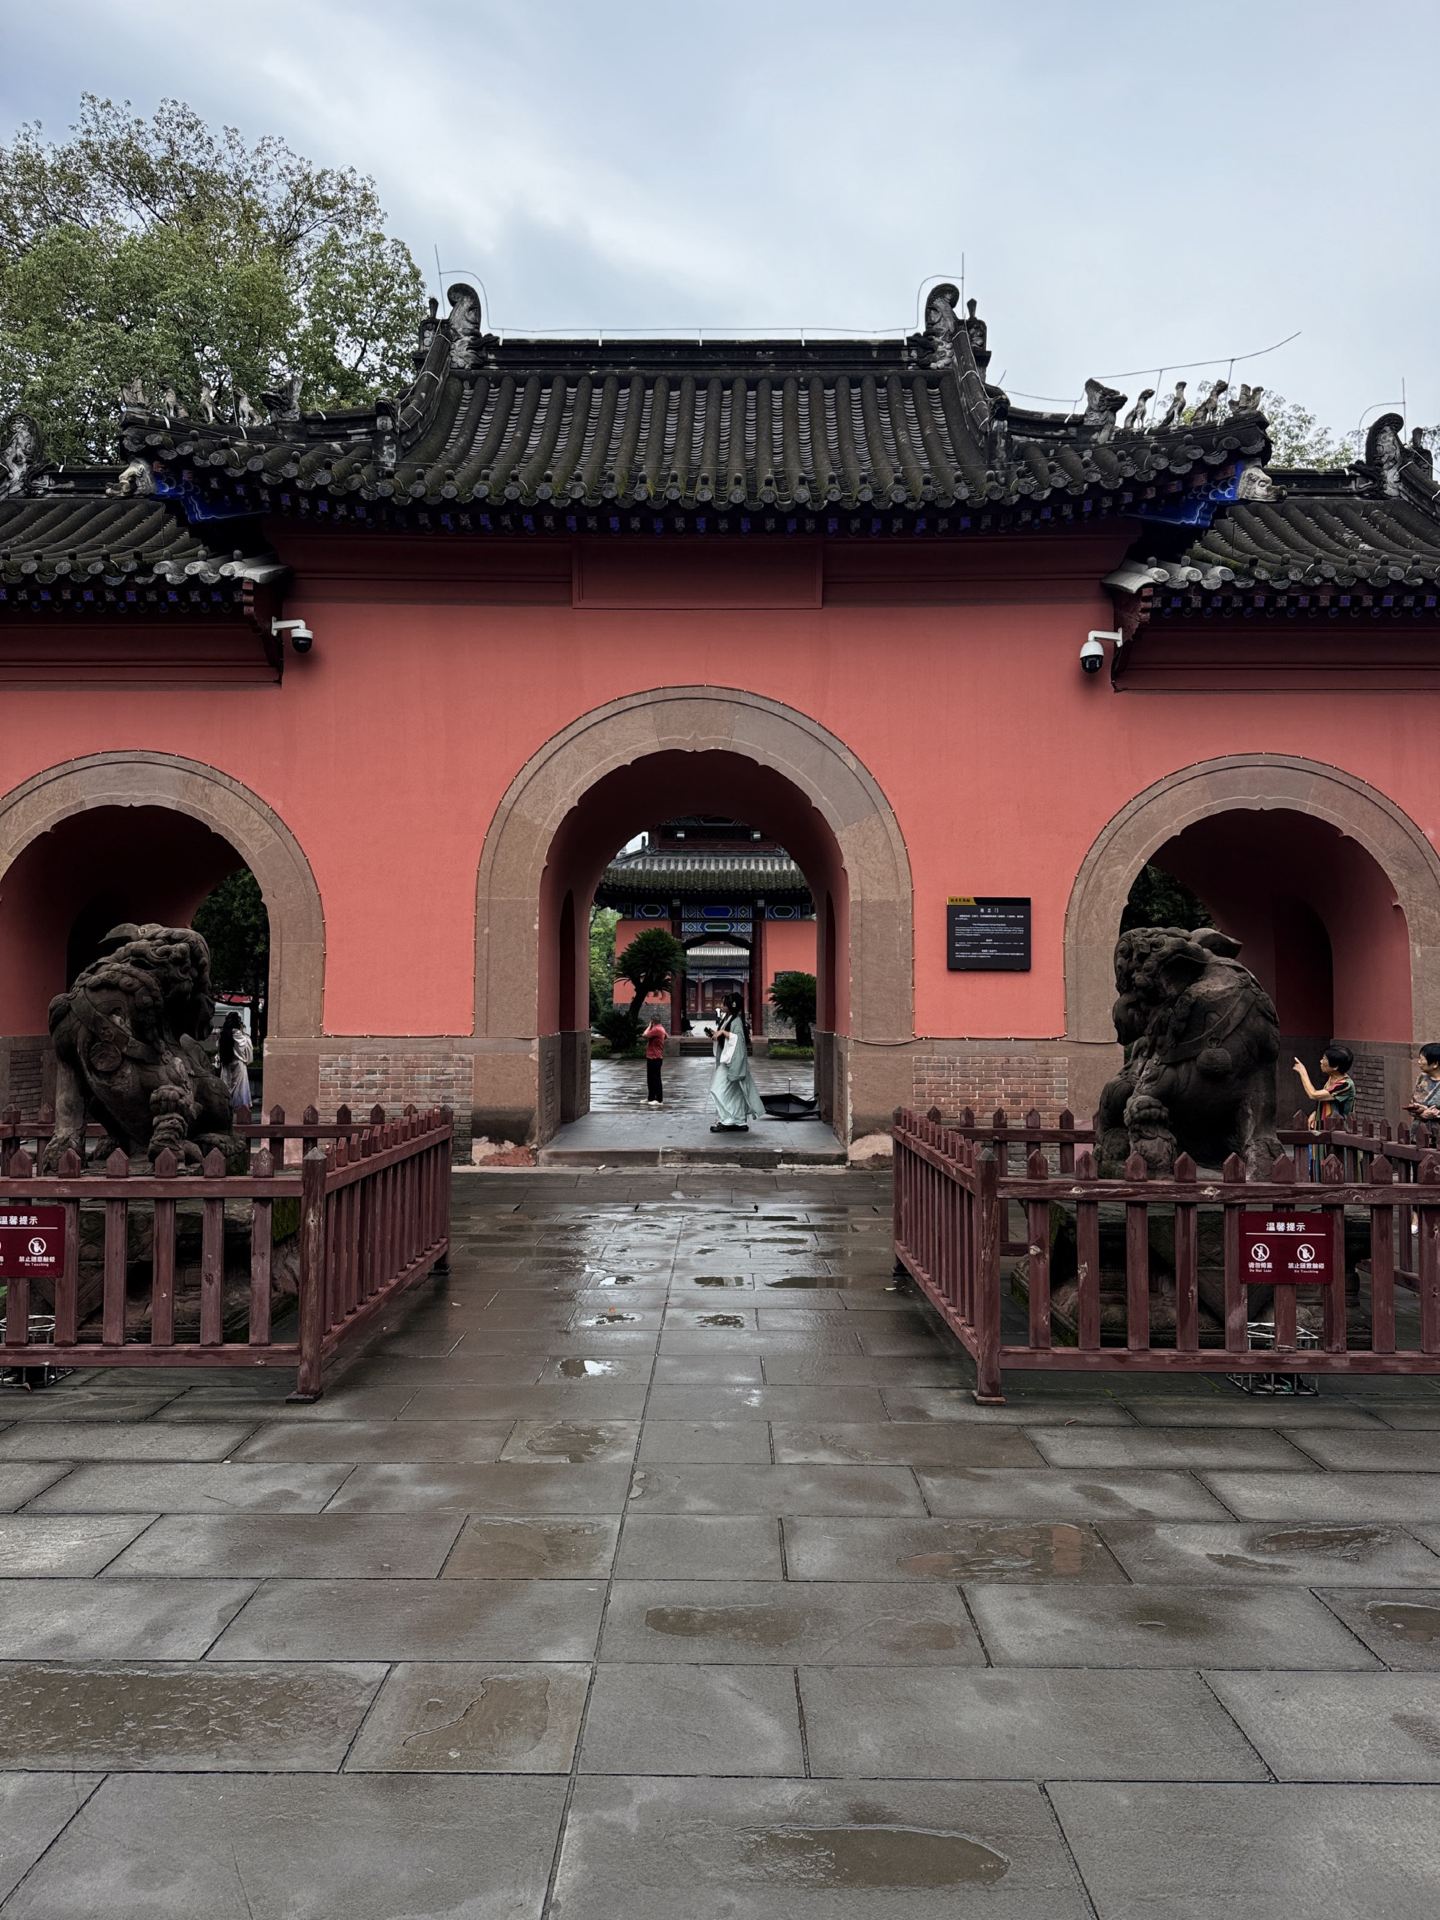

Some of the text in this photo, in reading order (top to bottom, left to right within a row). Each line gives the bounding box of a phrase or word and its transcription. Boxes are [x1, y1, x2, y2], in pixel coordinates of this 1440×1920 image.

[0, 1216, 38, 1225] 温馨提示
[1266, 1222, 1306, 1232] 温馨提示
